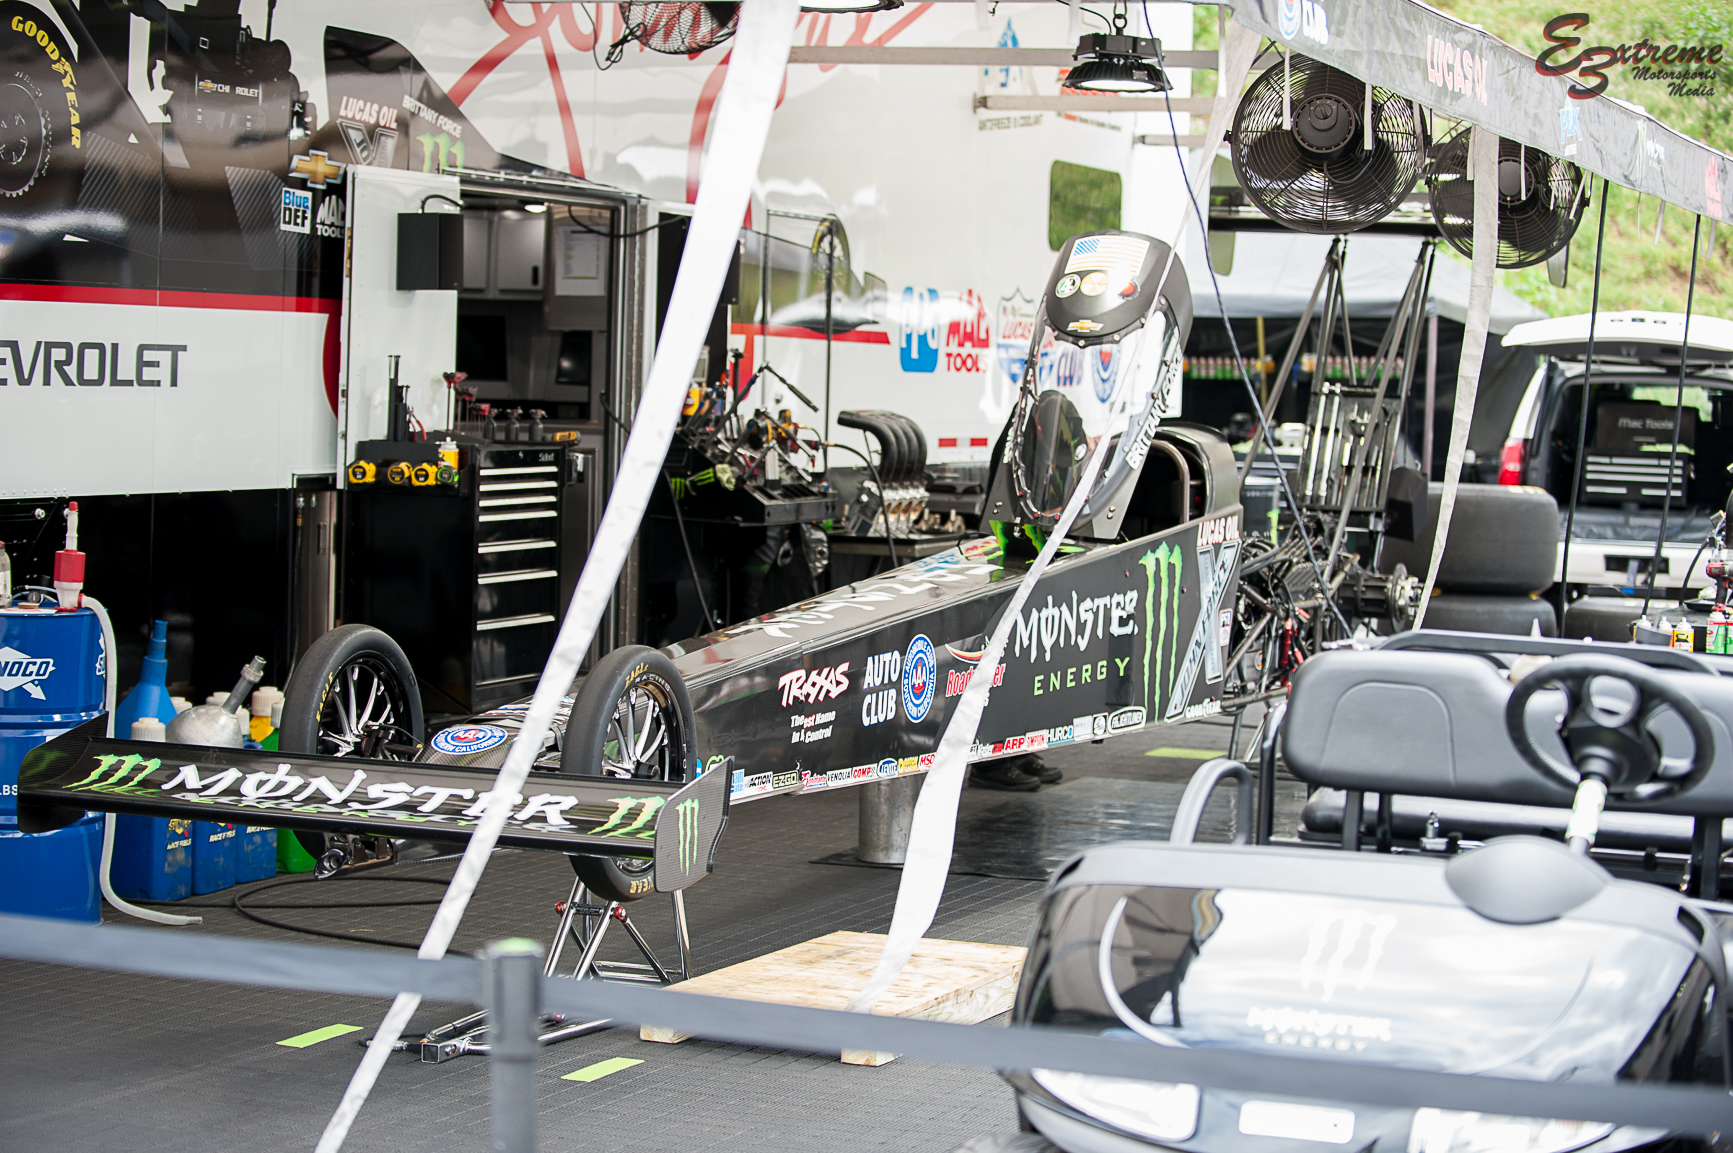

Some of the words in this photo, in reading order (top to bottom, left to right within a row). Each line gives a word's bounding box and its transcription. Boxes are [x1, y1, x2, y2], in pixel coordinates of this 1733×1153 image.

[1427, 35, 1473, 98] LUCAS
[12, 16, 82, 149] GOODYEAR
[339, 96, 379, 125] LUCAS
[379, 105, 398, 129] OIL
[402, 94, 439, 126] BRITTANY
[437, 114, 463, 138] FORCE
[284, 190, 309, 209] Blue
[282, 207, 309, 228] DEF
[1197, 521, 1225, 547] LUCAS
[1226, 515, 1240, 541] OIL
[863, 650, 900, 690] AUTO
[911, 665, 927, 688] AAA
[1033, 657, 1130, 696] ENERGY
[635, 674, 671, 692] RACING
[861, 687, 898, 728] CLUB
[454, 729, 485, 739] AAA
[805, 724, 833, 744] Control
[1047, 725, 1074, 743] HURCO
[1005, 738, 1025, 751] ARP
[920, 753, 935, 766] MSD
[827, 769, 851, 782] VENOLIA
[852, 766, 871, 779] COMP
[0, 784, 18, 796] BS
